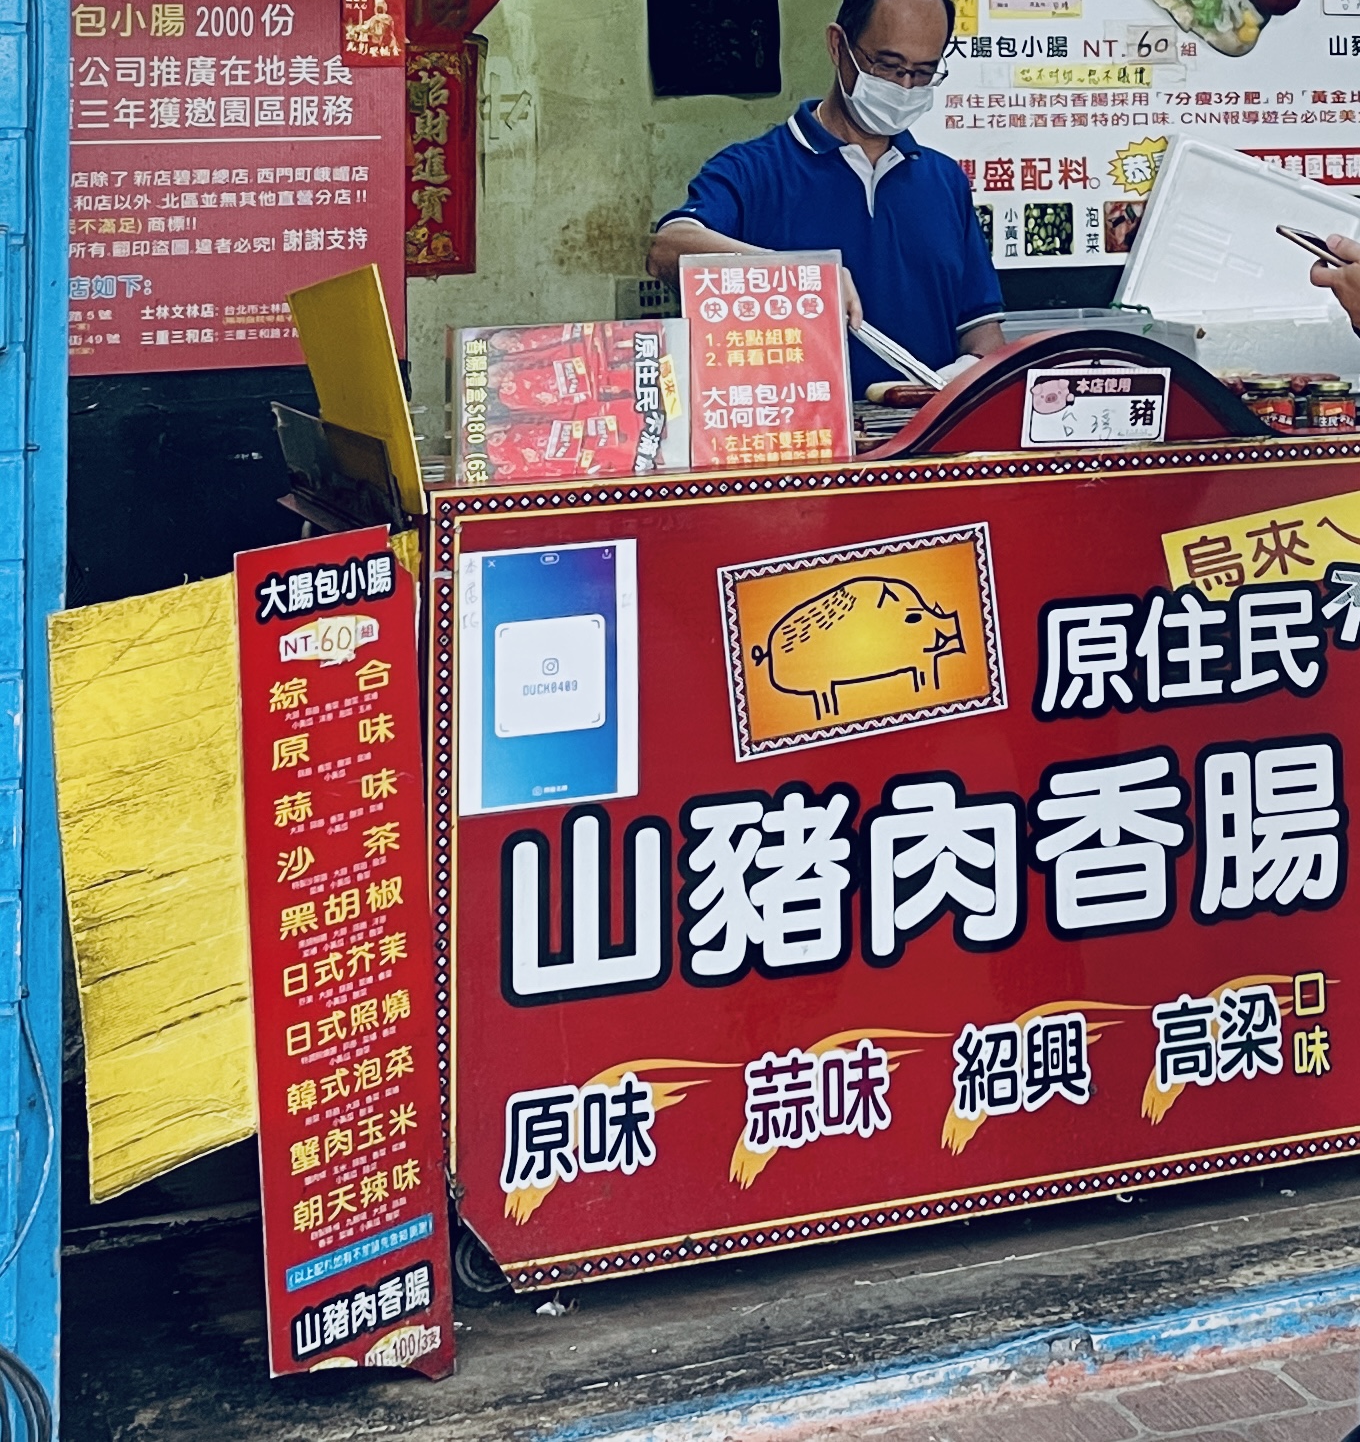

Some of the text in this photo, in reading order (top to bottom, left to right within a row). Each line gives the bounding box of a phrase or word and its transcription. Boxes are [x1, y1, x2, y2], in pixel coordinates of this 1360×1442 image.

[72, 3, 295, 37] 包小腸 2000 份
[945, 36, 1068, 58] 大腸包小腸
[1137, 30, 1169, 57] 60
[1181, 42, 1197, 56] 組
[70, 55, 353, 88] 公司推廣在地美食
[70, 96, 353, 130] 三年獲邀園區服務
[283, 228, 368, 251] 謝謝支持
[1004, 208, 1019, 257] 小黃瓜
[1085, 207, 1099, 253] 泡菜
[694, 265, 821, 296] 大腸包小腸
[702, 295, 822, 322] 快速點餐
[726, 329, 802, 348] 先點組數
[727, 348, 804, 367] 再看口味
[702, 381, 830, 408] 大腸包小腸
[1076, 378, 1132, 393] 本店使用
[704, 407, 794, 430] 如何吃?
[1130, 400, 1155, 427] 豬
[261, 558, 391, 618] 大腸包小腸
[321, 625, 353, 653] 60
[279, 876, 403, 940] 黑胡椒
[287, 989, 411, 1056] 日式照燒
[1294, 972, 1331, 1075] 口味
[287, 1046, 414, 1115] 韓式泡菜
[955, 1016, 1088, 1114] 紹興
[747, 1046, 889, 1146] 蒜味
[290, 1102, 418, 1176] 蟹肉玉米
[507, 1077, 652, 1186] 原味
[294, 1159, 420, 1233] 朝天辣味
[296, 1266, 430, 1356] 山豬肉香腸
